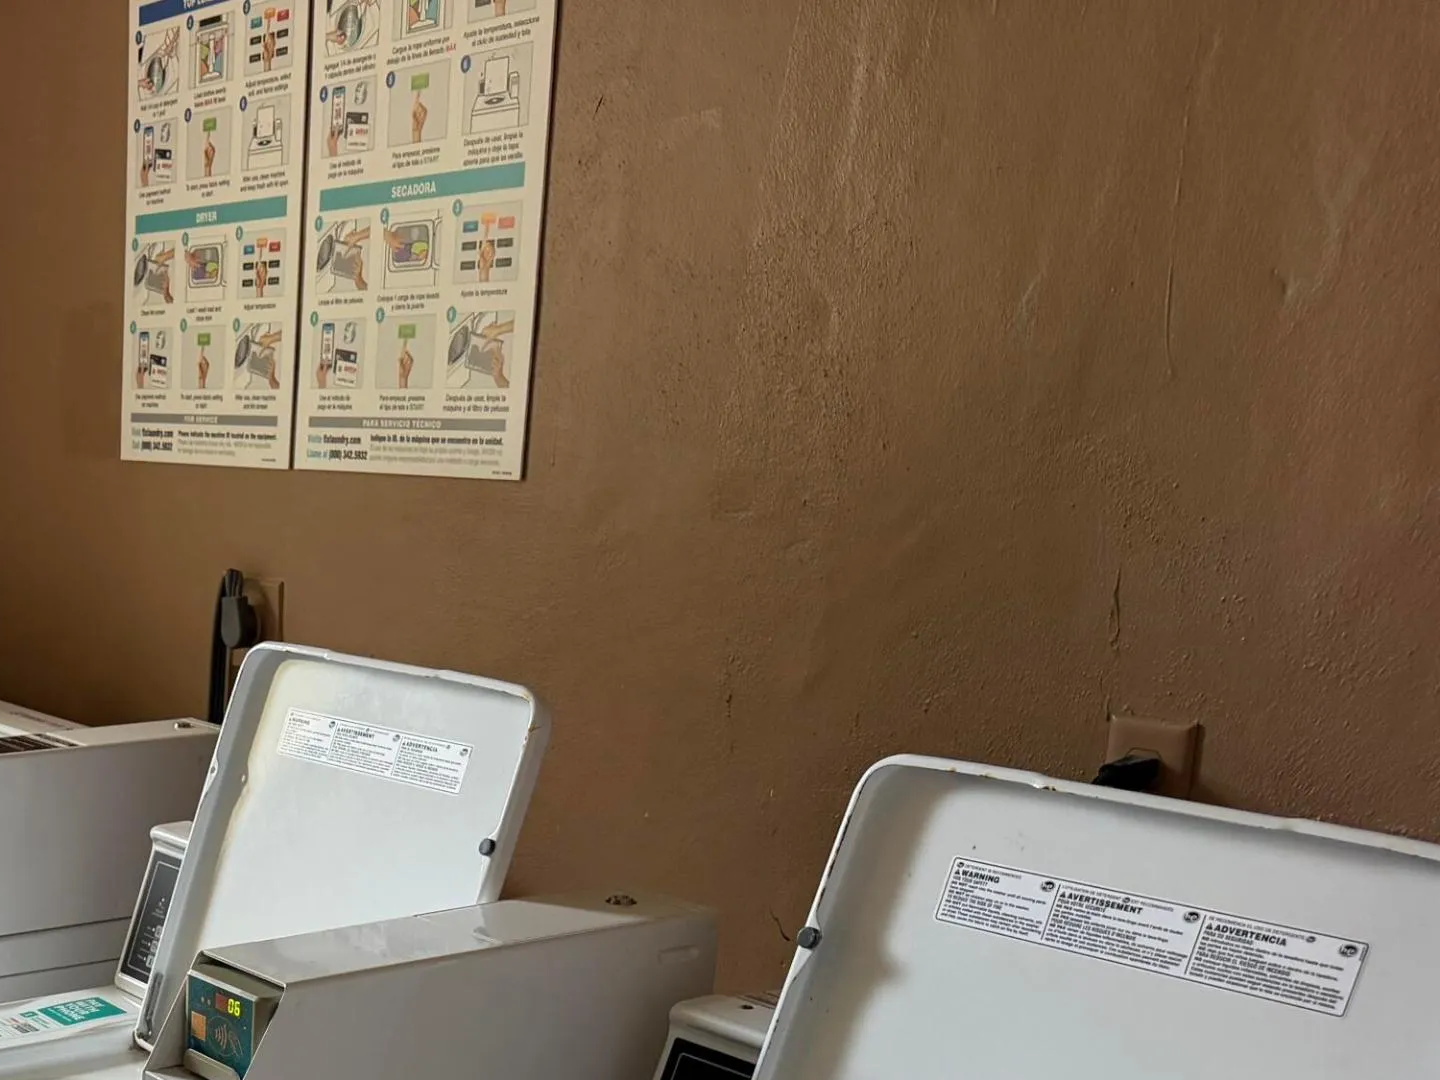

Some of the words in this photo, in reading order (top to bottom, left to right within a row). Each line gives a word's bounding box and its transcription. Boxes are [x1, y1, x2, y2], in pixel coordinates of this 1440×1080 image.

[391, 181, 436, 198] SECADORA
[961, 869, 1000, 884] WARNING
[1068, 892, 1144, 915] AVERTISSEMENT
[1213, 924, 1288, 947] ADVERTENCIA
[227, 998, 241, 1018] 06
